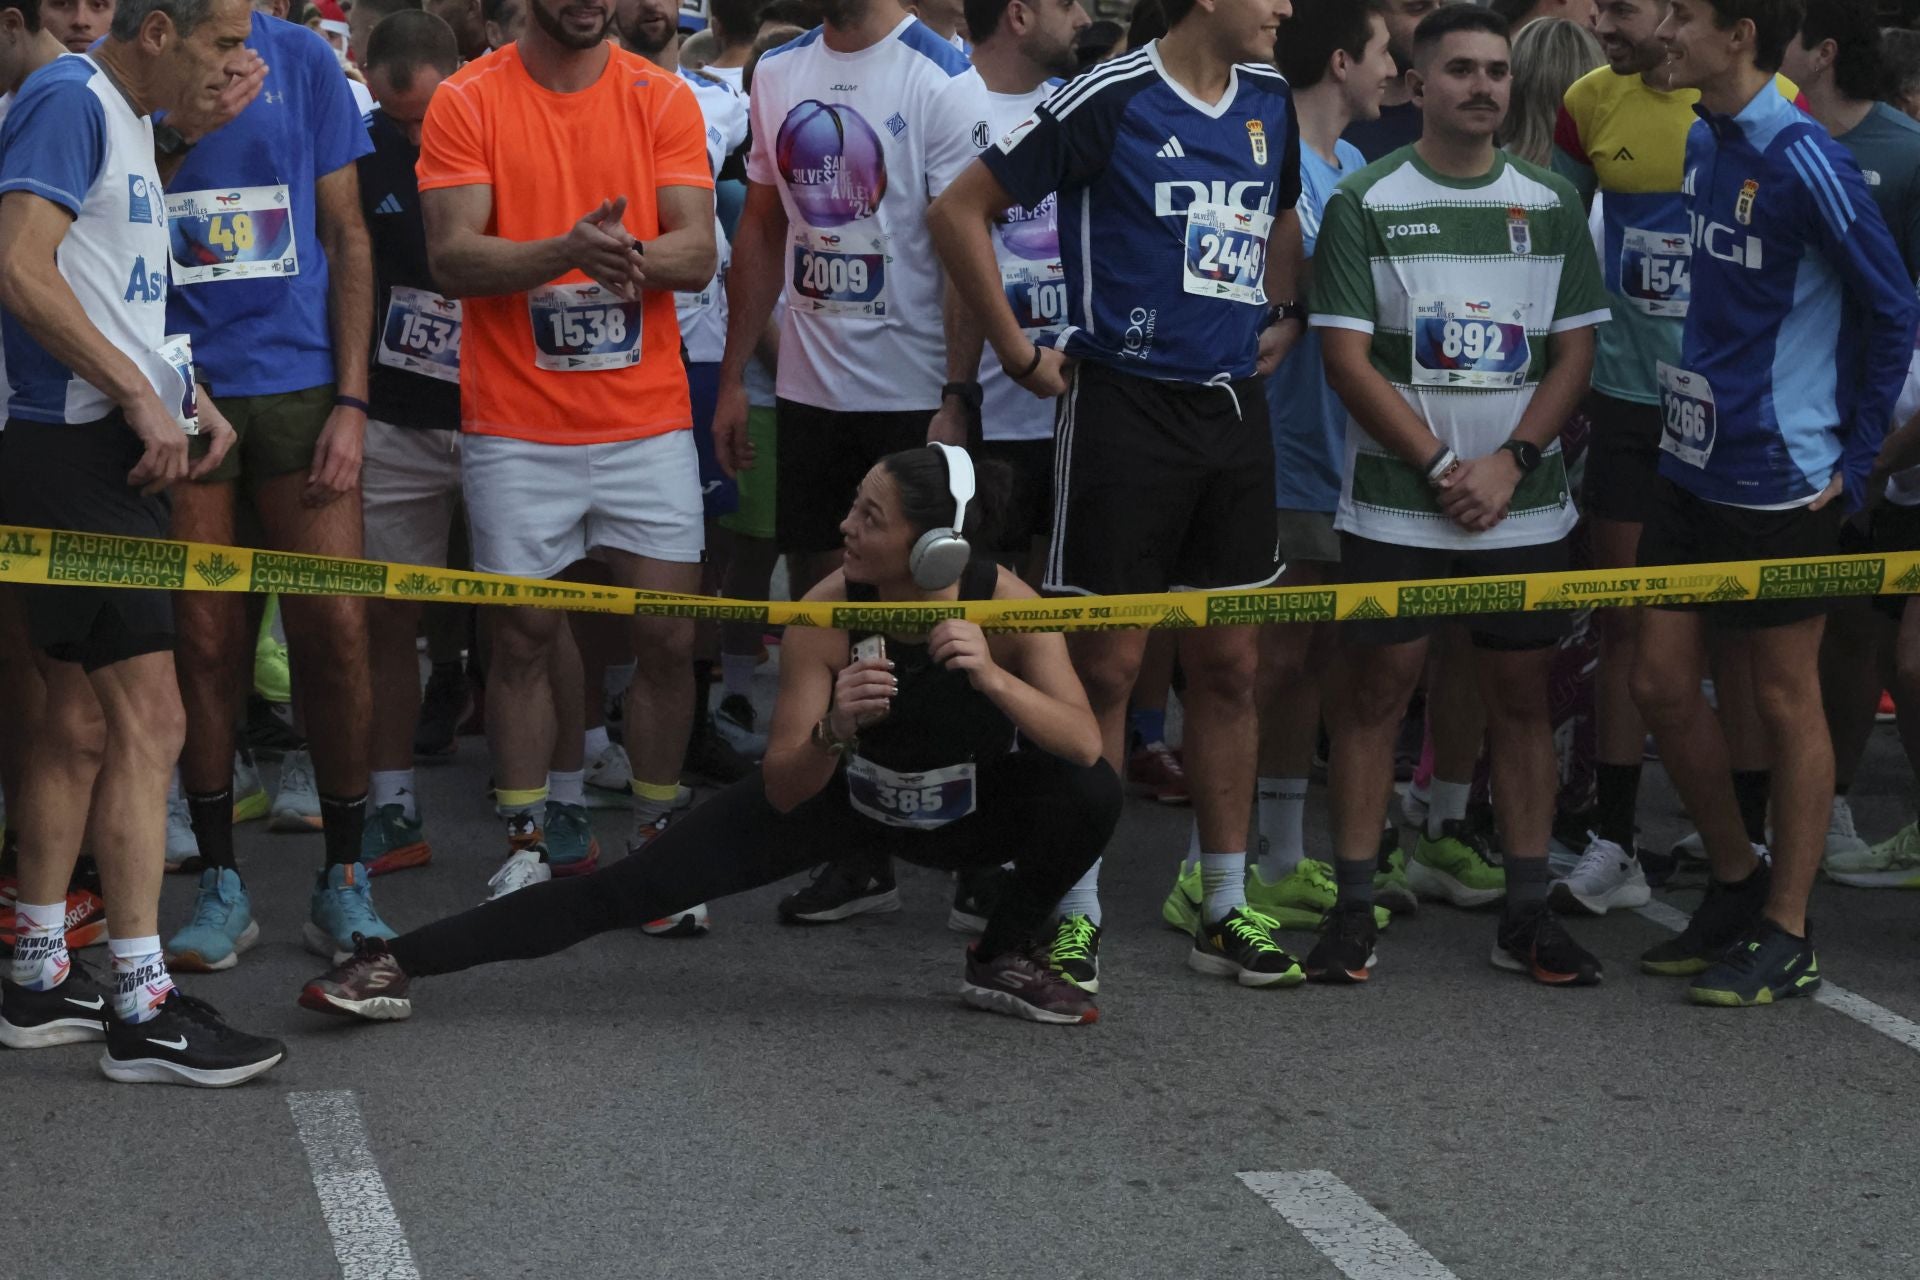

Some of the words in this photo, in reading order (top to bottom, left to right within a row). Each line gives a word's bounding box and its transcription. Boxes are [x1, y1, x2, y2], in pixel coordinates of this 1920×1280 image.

[824, 155, 846, 170] SAN
[208, 214, 255, 252] 48
[1199, 233, 1261, 280] 2449
[802, 254, 868, 294] 2009
[549, 308, 626, 348] 1538
[1442, 321, 1505, 360] 892
[1664, 393, 1707, 442] 2266
[54, 534, 184, 563] FABRICADO
[53, 552, 89, 570] CON
[97, 557, 182, 578] MATERIAL
[1779, 560, 1883, 582] AMBIENTE
[52, 566, 159, 587] RECICLADO
[254, 567, 294, 585] CON
[300, 571, 320, 588] EL
[325, 574, 382, 593] MEDIO
[1646, 577, 1667, 591] DE
[1822, 580, 1840, 592] EL
[1842, 577, 1880, 590] CON
[1421, 582, 1522, 602] RECICLADO
[1561, 579, 1640, 595] ASTURIAS
[1761, 582, 1815, 596] MEDIO
[1089, 606, 1112, 618] DE
[1227, 592, 1333, 612] AMBIENTE
[1404, 599, 1481, 616] MATERIAL
[1487, 598, 1522, 611] CON
[1001, 608, 1083, 620] ASTURIAS
[876, 785, 943, 813] 385
